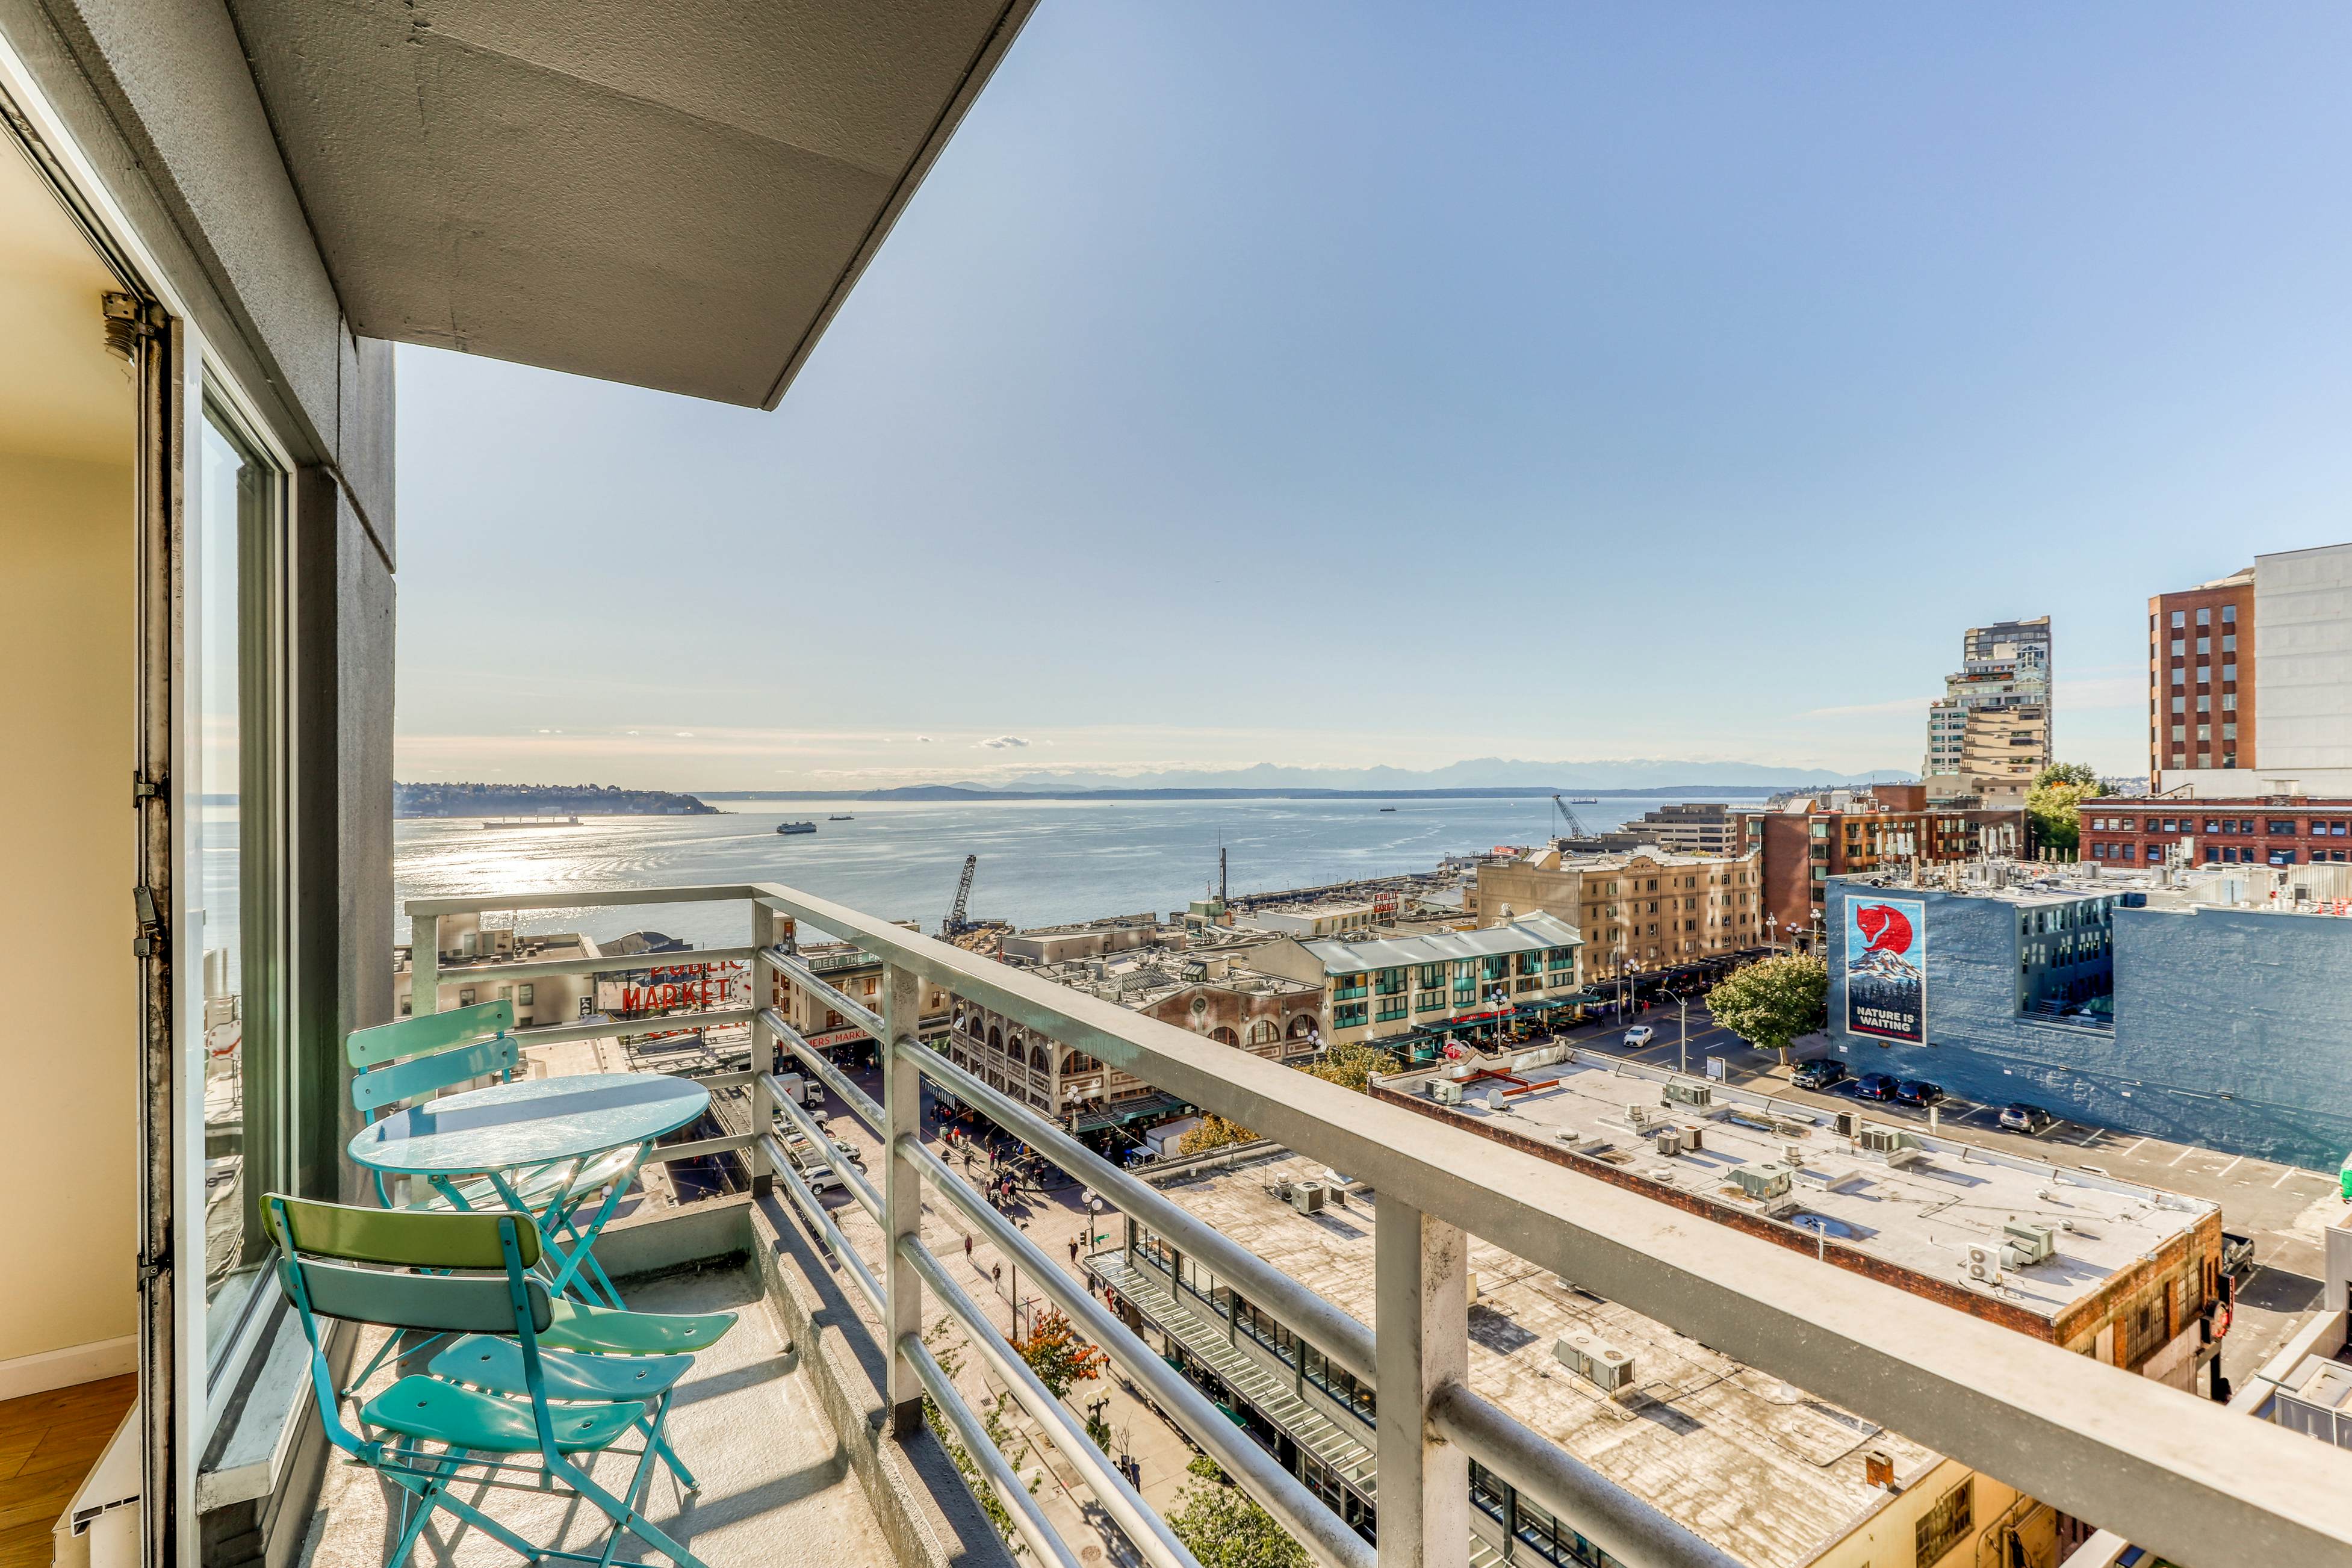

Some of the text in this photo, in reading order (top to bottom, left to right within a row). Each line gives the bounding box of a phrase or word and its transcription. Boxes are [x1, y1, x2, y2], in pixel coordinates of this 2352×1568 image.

[814, 957, 839, 968] MEET
[845, 954, 863, 964] THE
[622, 978, 730, 1012] MARKET
[582, 998, 591, 1015] LAS
[1857, 1006, 1914, 1023] NATURE IS
[1860, 1015, 1911, 1032] WAITING
[835, 1029, 869, 1043] MARKE
